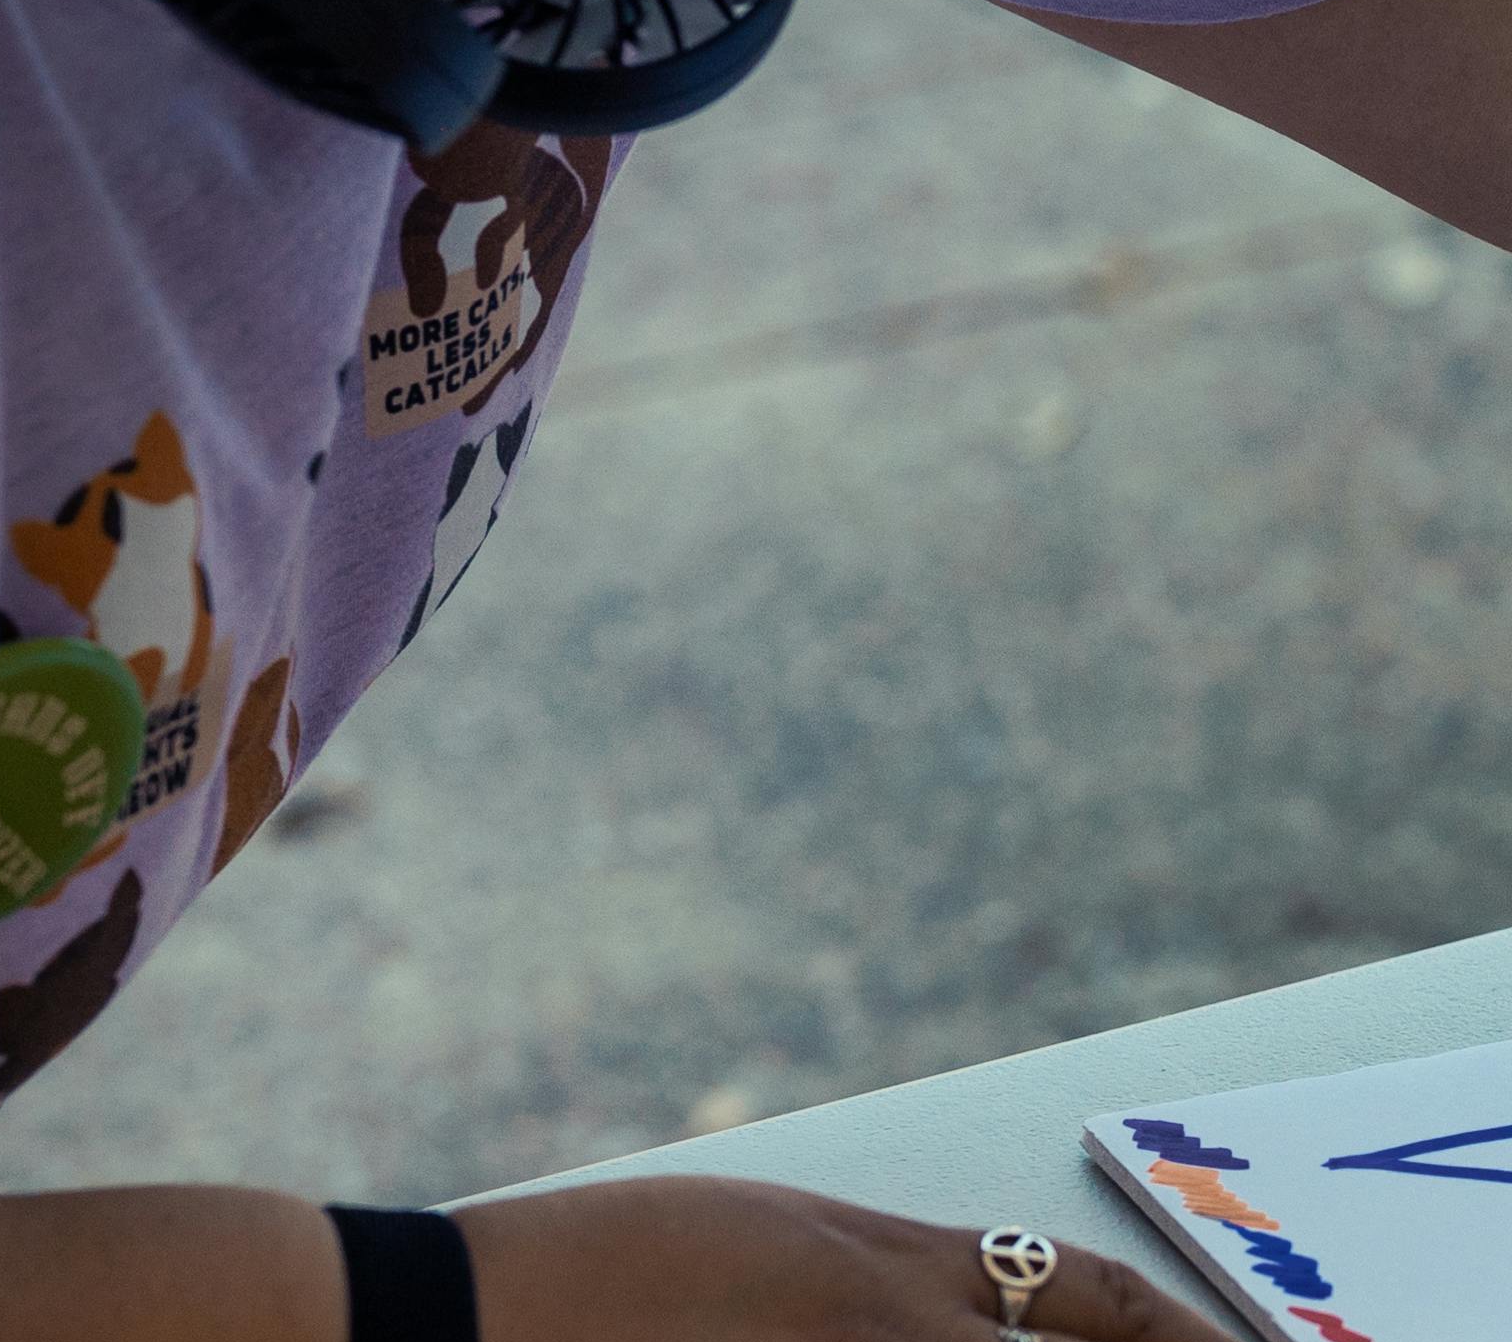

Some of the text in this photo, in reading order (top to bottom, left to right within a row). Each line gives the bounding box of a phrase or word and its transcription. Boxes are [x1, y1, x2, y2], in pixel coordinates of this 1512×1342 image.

[367, 265, 527, 363] MORE CATS,
[425, 319, 492, 376] LESS
[383, 328, 514, 415] CATCALLS
